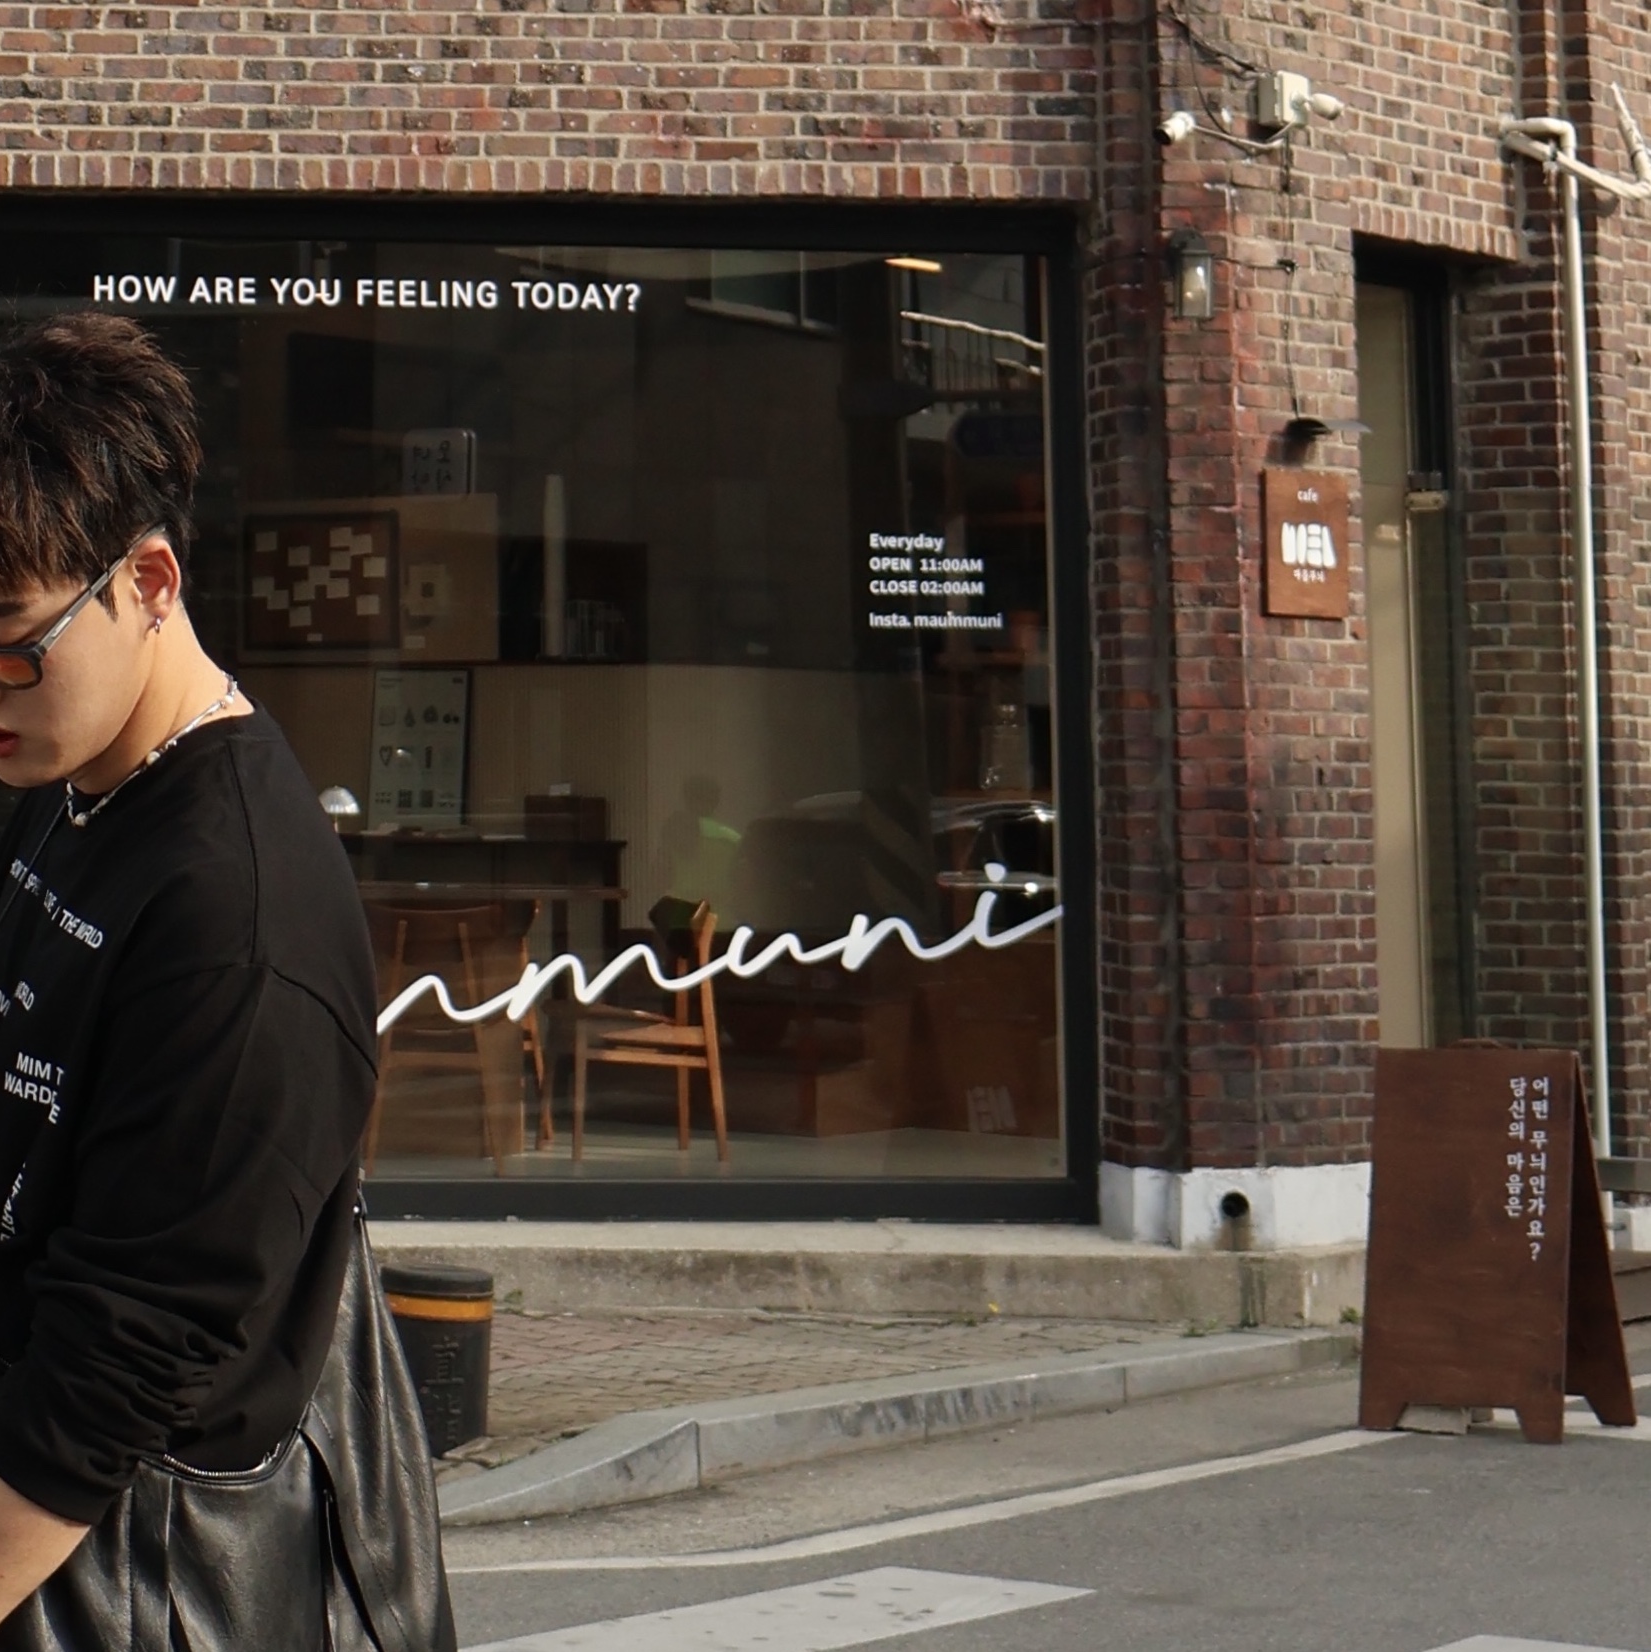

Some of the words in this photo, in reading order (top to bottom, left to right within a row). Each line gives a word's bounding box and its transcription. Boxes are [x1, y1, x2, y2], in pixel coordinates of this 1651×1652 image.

[94, 275, 177, 302] HOW
[189, 277, 256, 304] ARE
[270, 278, 341, 305] YOU
[357, 280, 498, 308] FEELING
[512, 282, 642, 311] TODAY?
[1297, 488, 1319, 502] cafe
[869, 533, 945, 552] Everyday
[869, 557, 912, 571] OPEN
[920, 558, 983, 572] 11:00AM
[869, 579, 918, 594] CLOSE
[920, 581, 985, 595] 02:00AM
[869, 612, 912, 628] Insta.
[59, 909, 81, 934] THE
[16, 1052, 52, 1081] MIM
[1508, 1077, 1527, 1141] 당신의
[1532, 1076, 1550, 1120] 어떤
[1504, 1152, 1525, 1218] 마음은
[1526, 1130, 1549, 1262] 무늬인가요?
